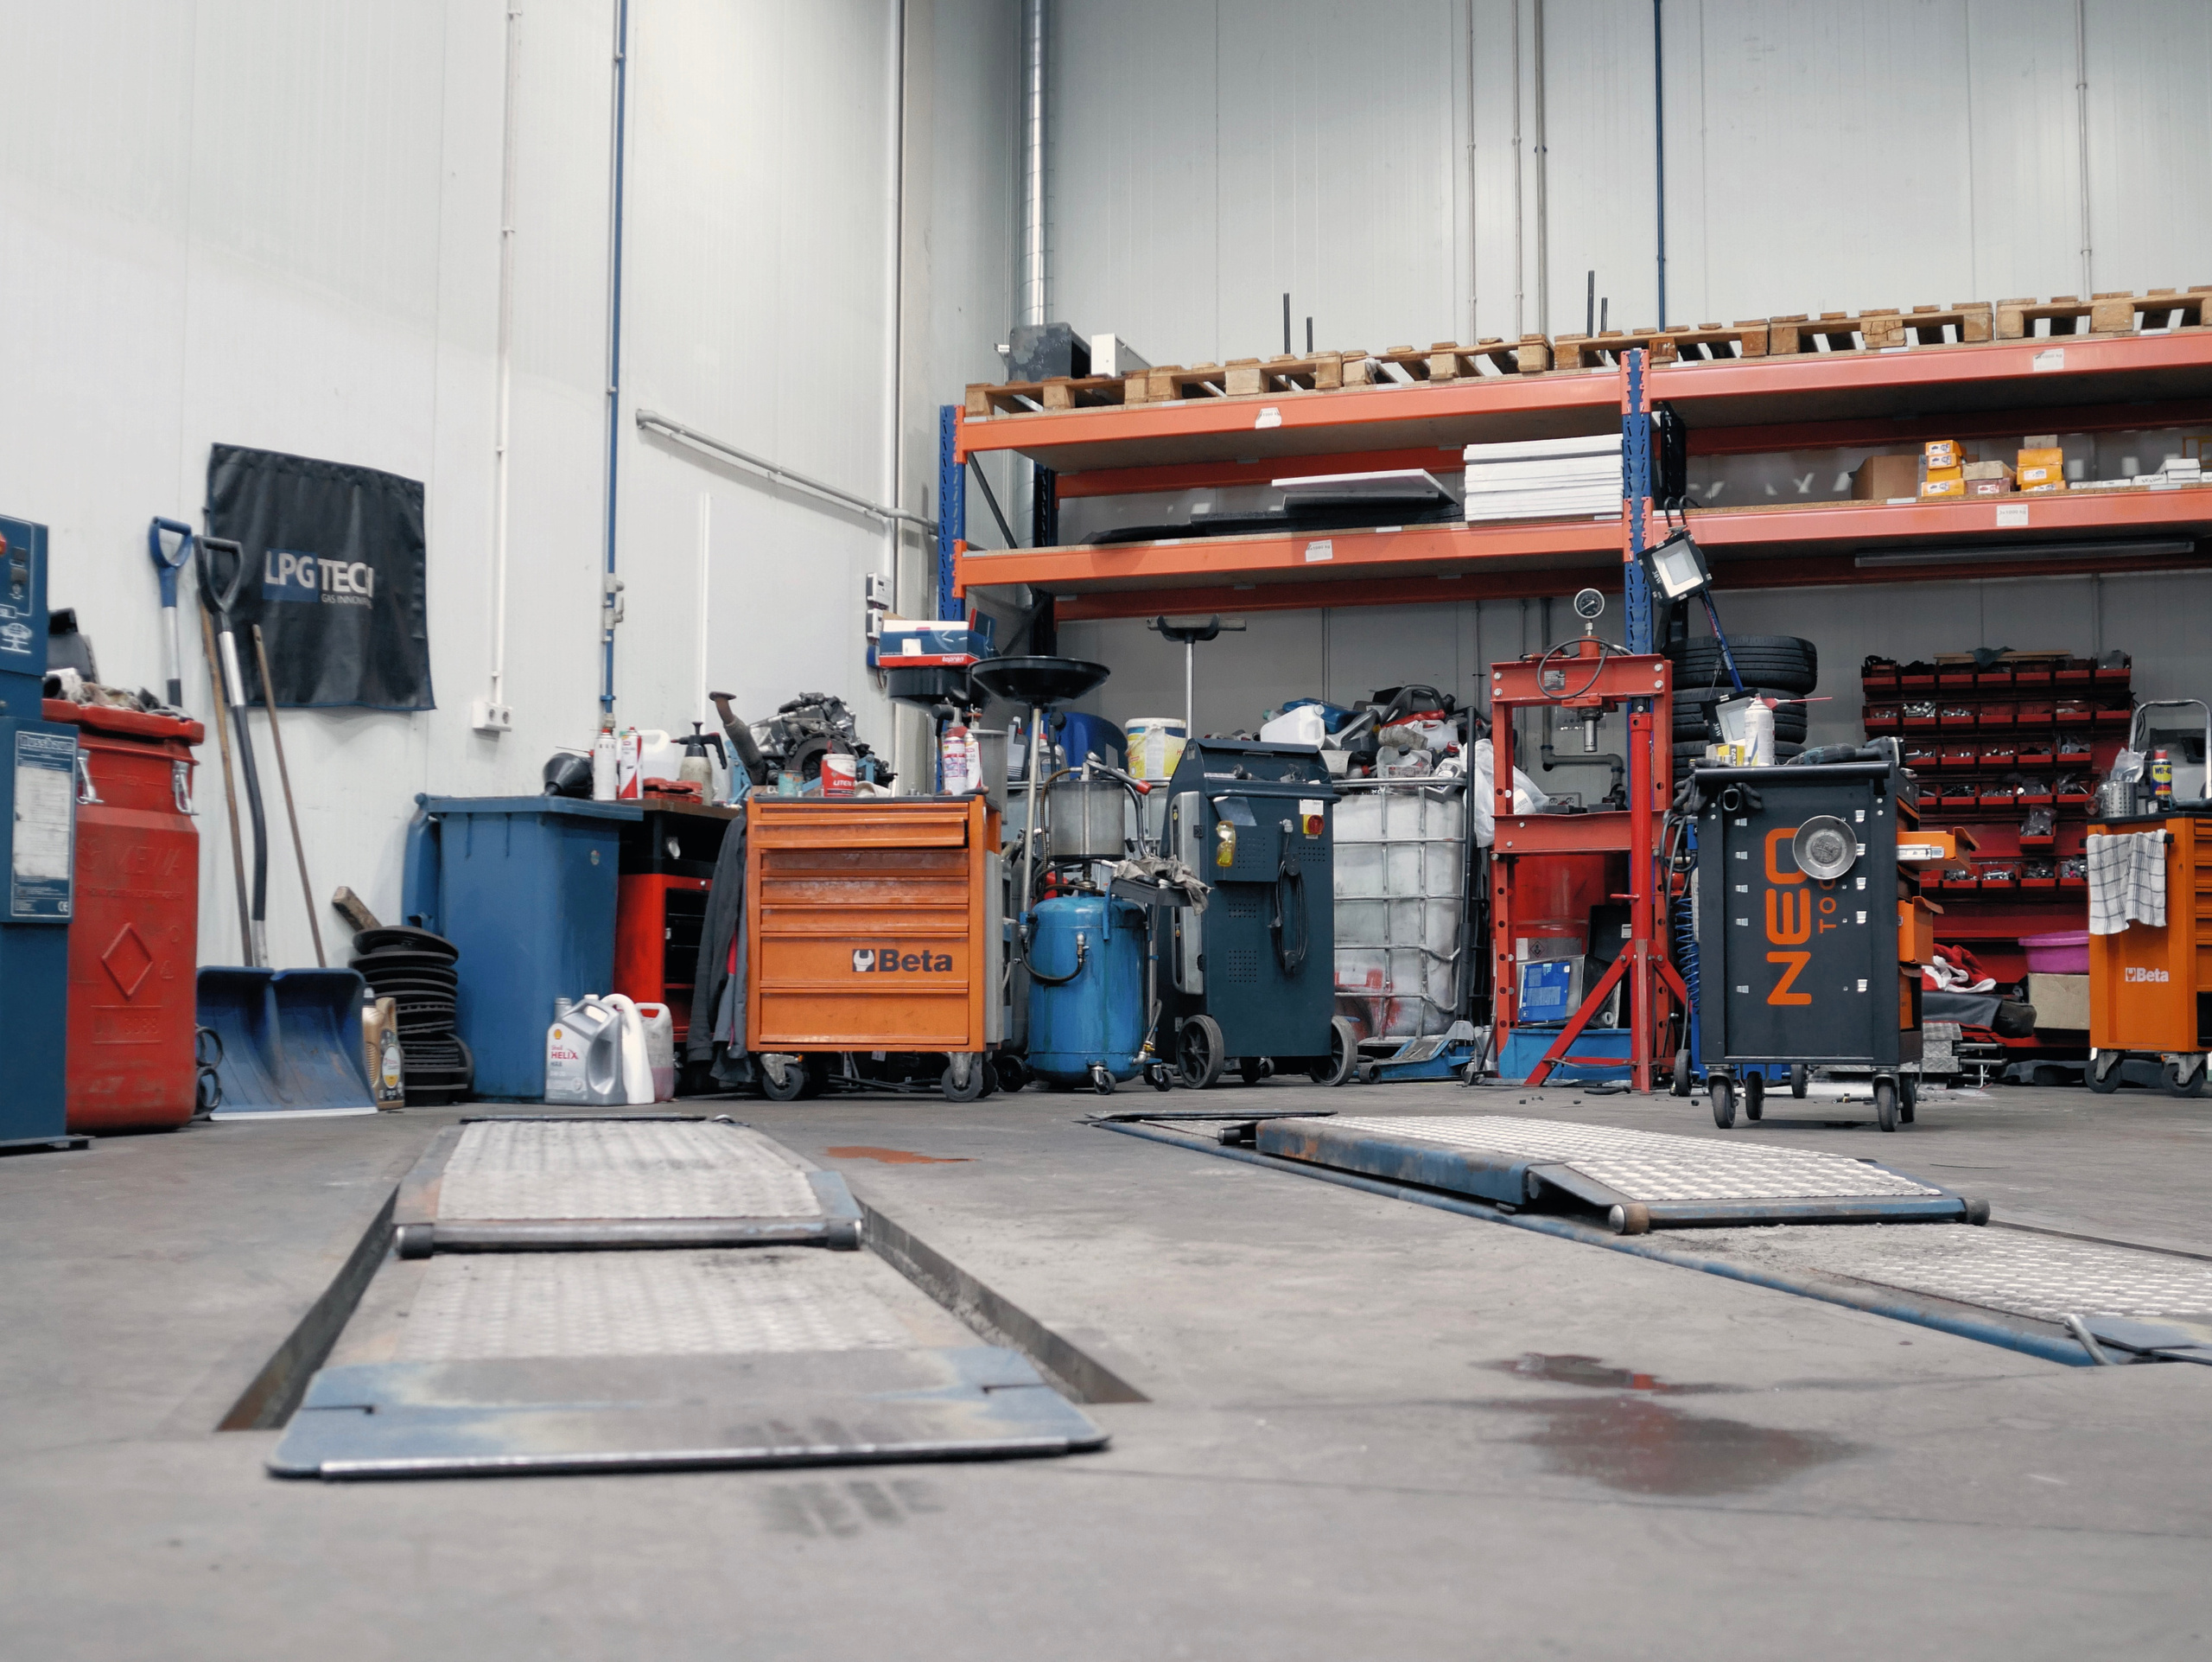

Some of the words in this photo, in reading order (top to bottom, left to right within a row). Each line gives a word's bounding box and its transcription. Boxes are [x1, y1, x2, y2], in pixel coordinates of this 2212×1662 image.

[264, 551, 316, 589] LPG
[1765, 827, 1812, 1005] NEO
[1819, 878, 1837, 934] TOO
[879, 949, 953, 972] Beta
[2136, 967, 2170, 983] Beta
[551, 1048, 578, 1060] HELIX
